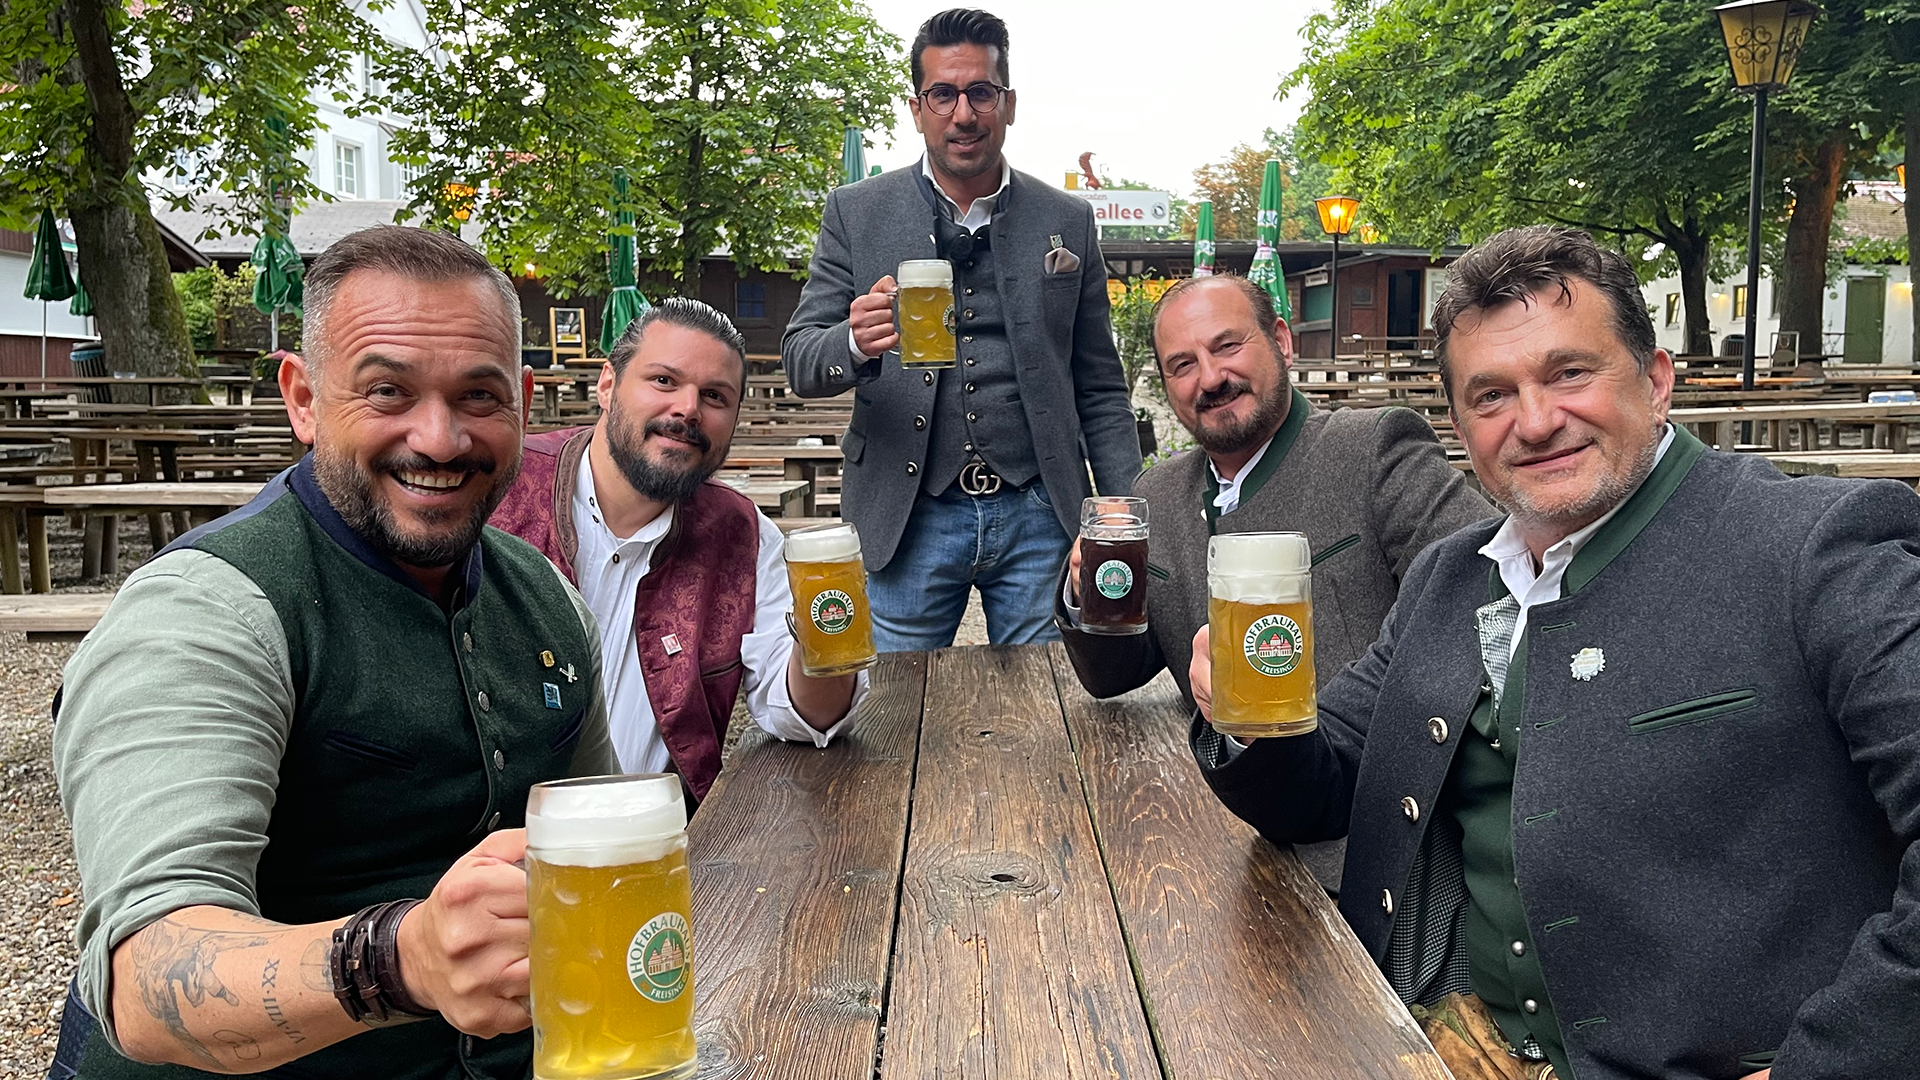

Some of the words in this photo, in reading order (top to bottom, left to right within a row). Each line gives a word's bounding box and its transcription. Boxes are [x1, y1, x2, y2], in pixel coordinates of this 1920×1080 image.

[1095, 203, 1144, 220] allee
[811, 590, 853, 620] HOFBRAUHAUS
[1245, 616, 1303, 653] HOFBRAUHAUS
[1260, 663, 1293, 674] FREISING
[629, 914, 691, 974] HOFBRAUHAUS
[650, 980, 684, 999] FREISING
